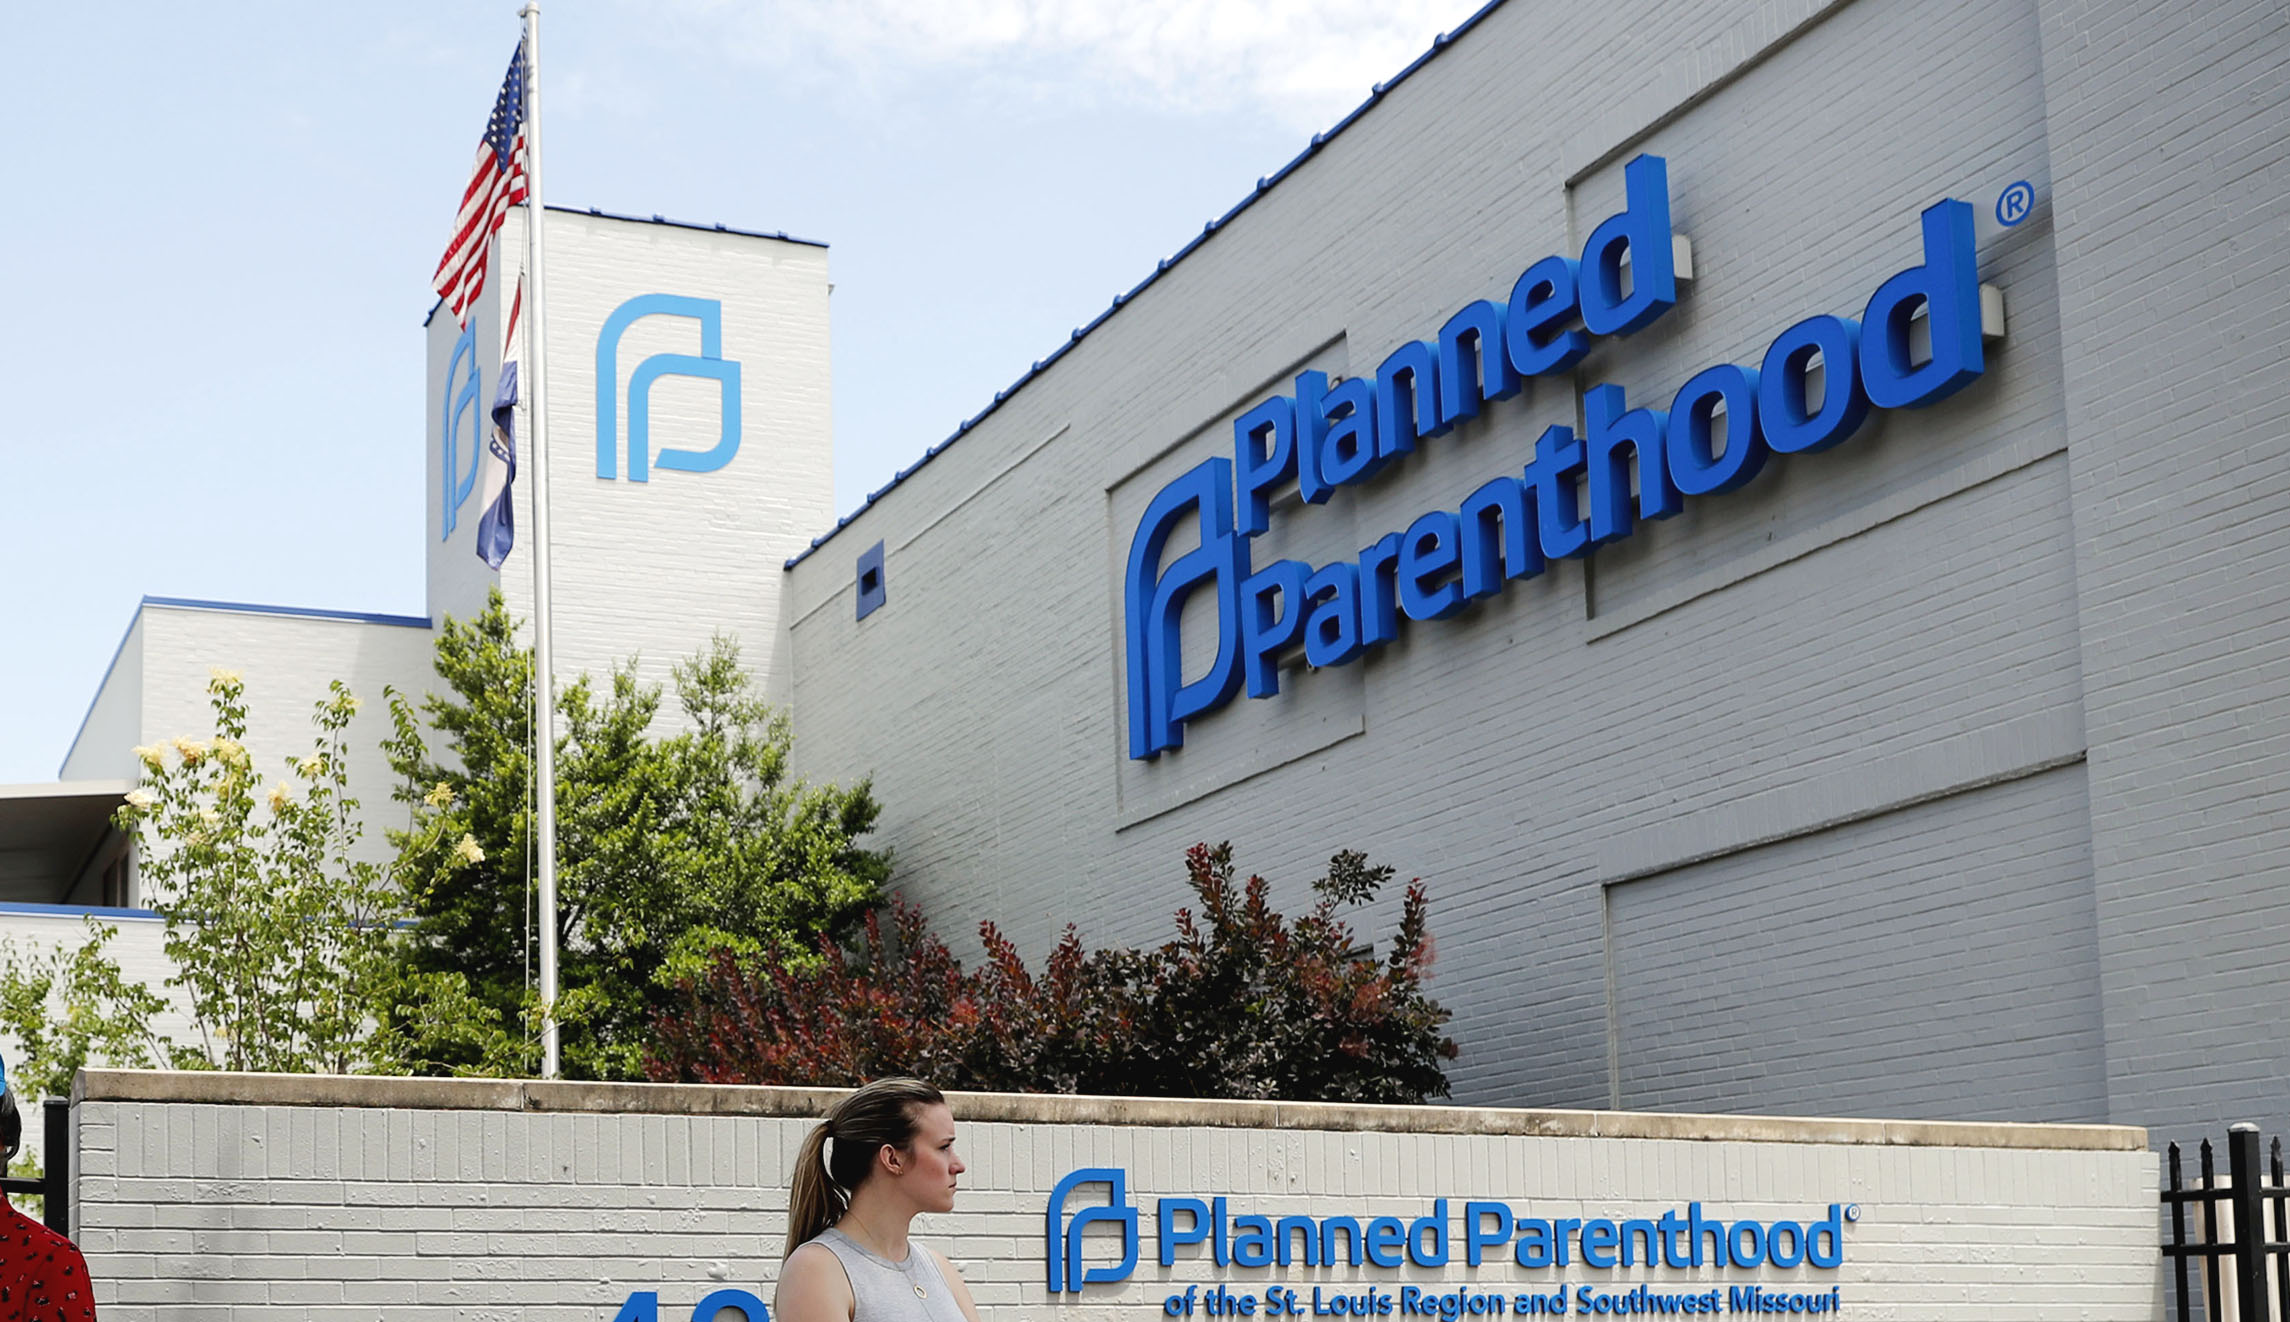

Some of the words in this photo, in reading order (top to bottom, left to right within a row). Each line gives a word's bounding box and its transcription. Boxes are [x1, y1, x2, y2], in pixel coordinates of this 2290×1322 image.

[1234, 153, 1677, 537] Planned
[1241, 197, 1985, 699] Parenthood
[1160, 1196, 1450, 1268] Planned
[1465, 1201, 1843, 1269] Parenthood
[1164, 1284, 1198, 1316] of
[1204, 1283, 1258, 1316] the
[1265, 1285, 1305, 1316] St.
[1313, 1285, 1394, 1316] Louis
[1401, 1285, 1508, 1322] Region
[1513, 1283, 1568, 1315] and
[1576, 1283, 1724, 1315] Southwest
[1729, 1285, 1841, 1314] Missouri
